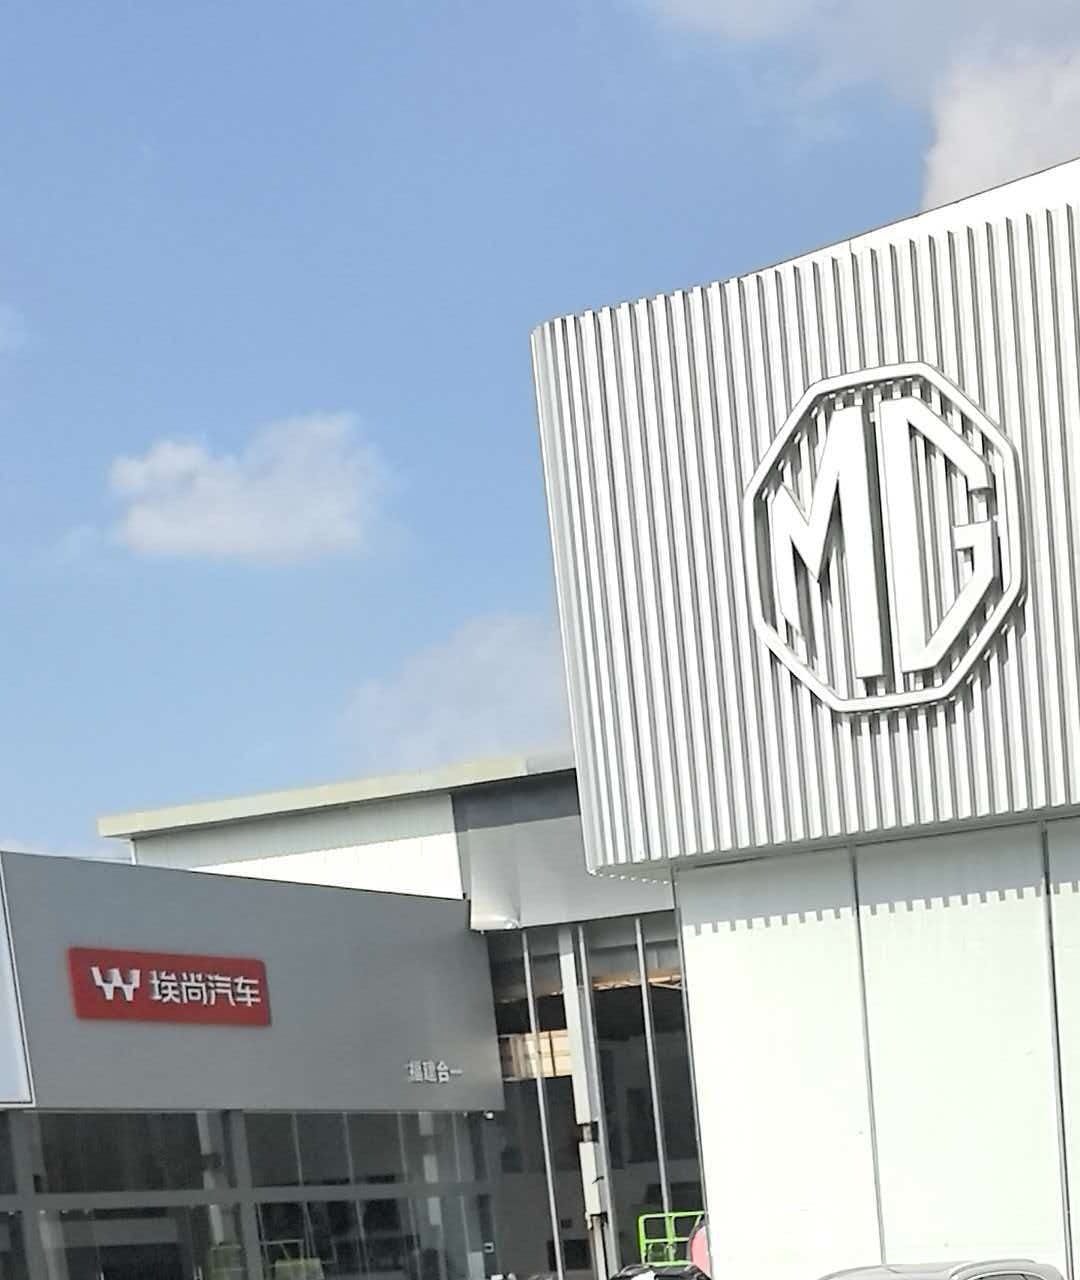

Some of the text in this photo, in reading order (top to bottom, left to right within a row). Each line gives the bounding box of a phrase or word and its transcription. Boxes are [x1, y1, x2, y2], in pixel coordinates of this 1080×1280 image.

[768, 392, 1002, 682] MG
[150, 969, 262, 1007] 埃尚汽车
